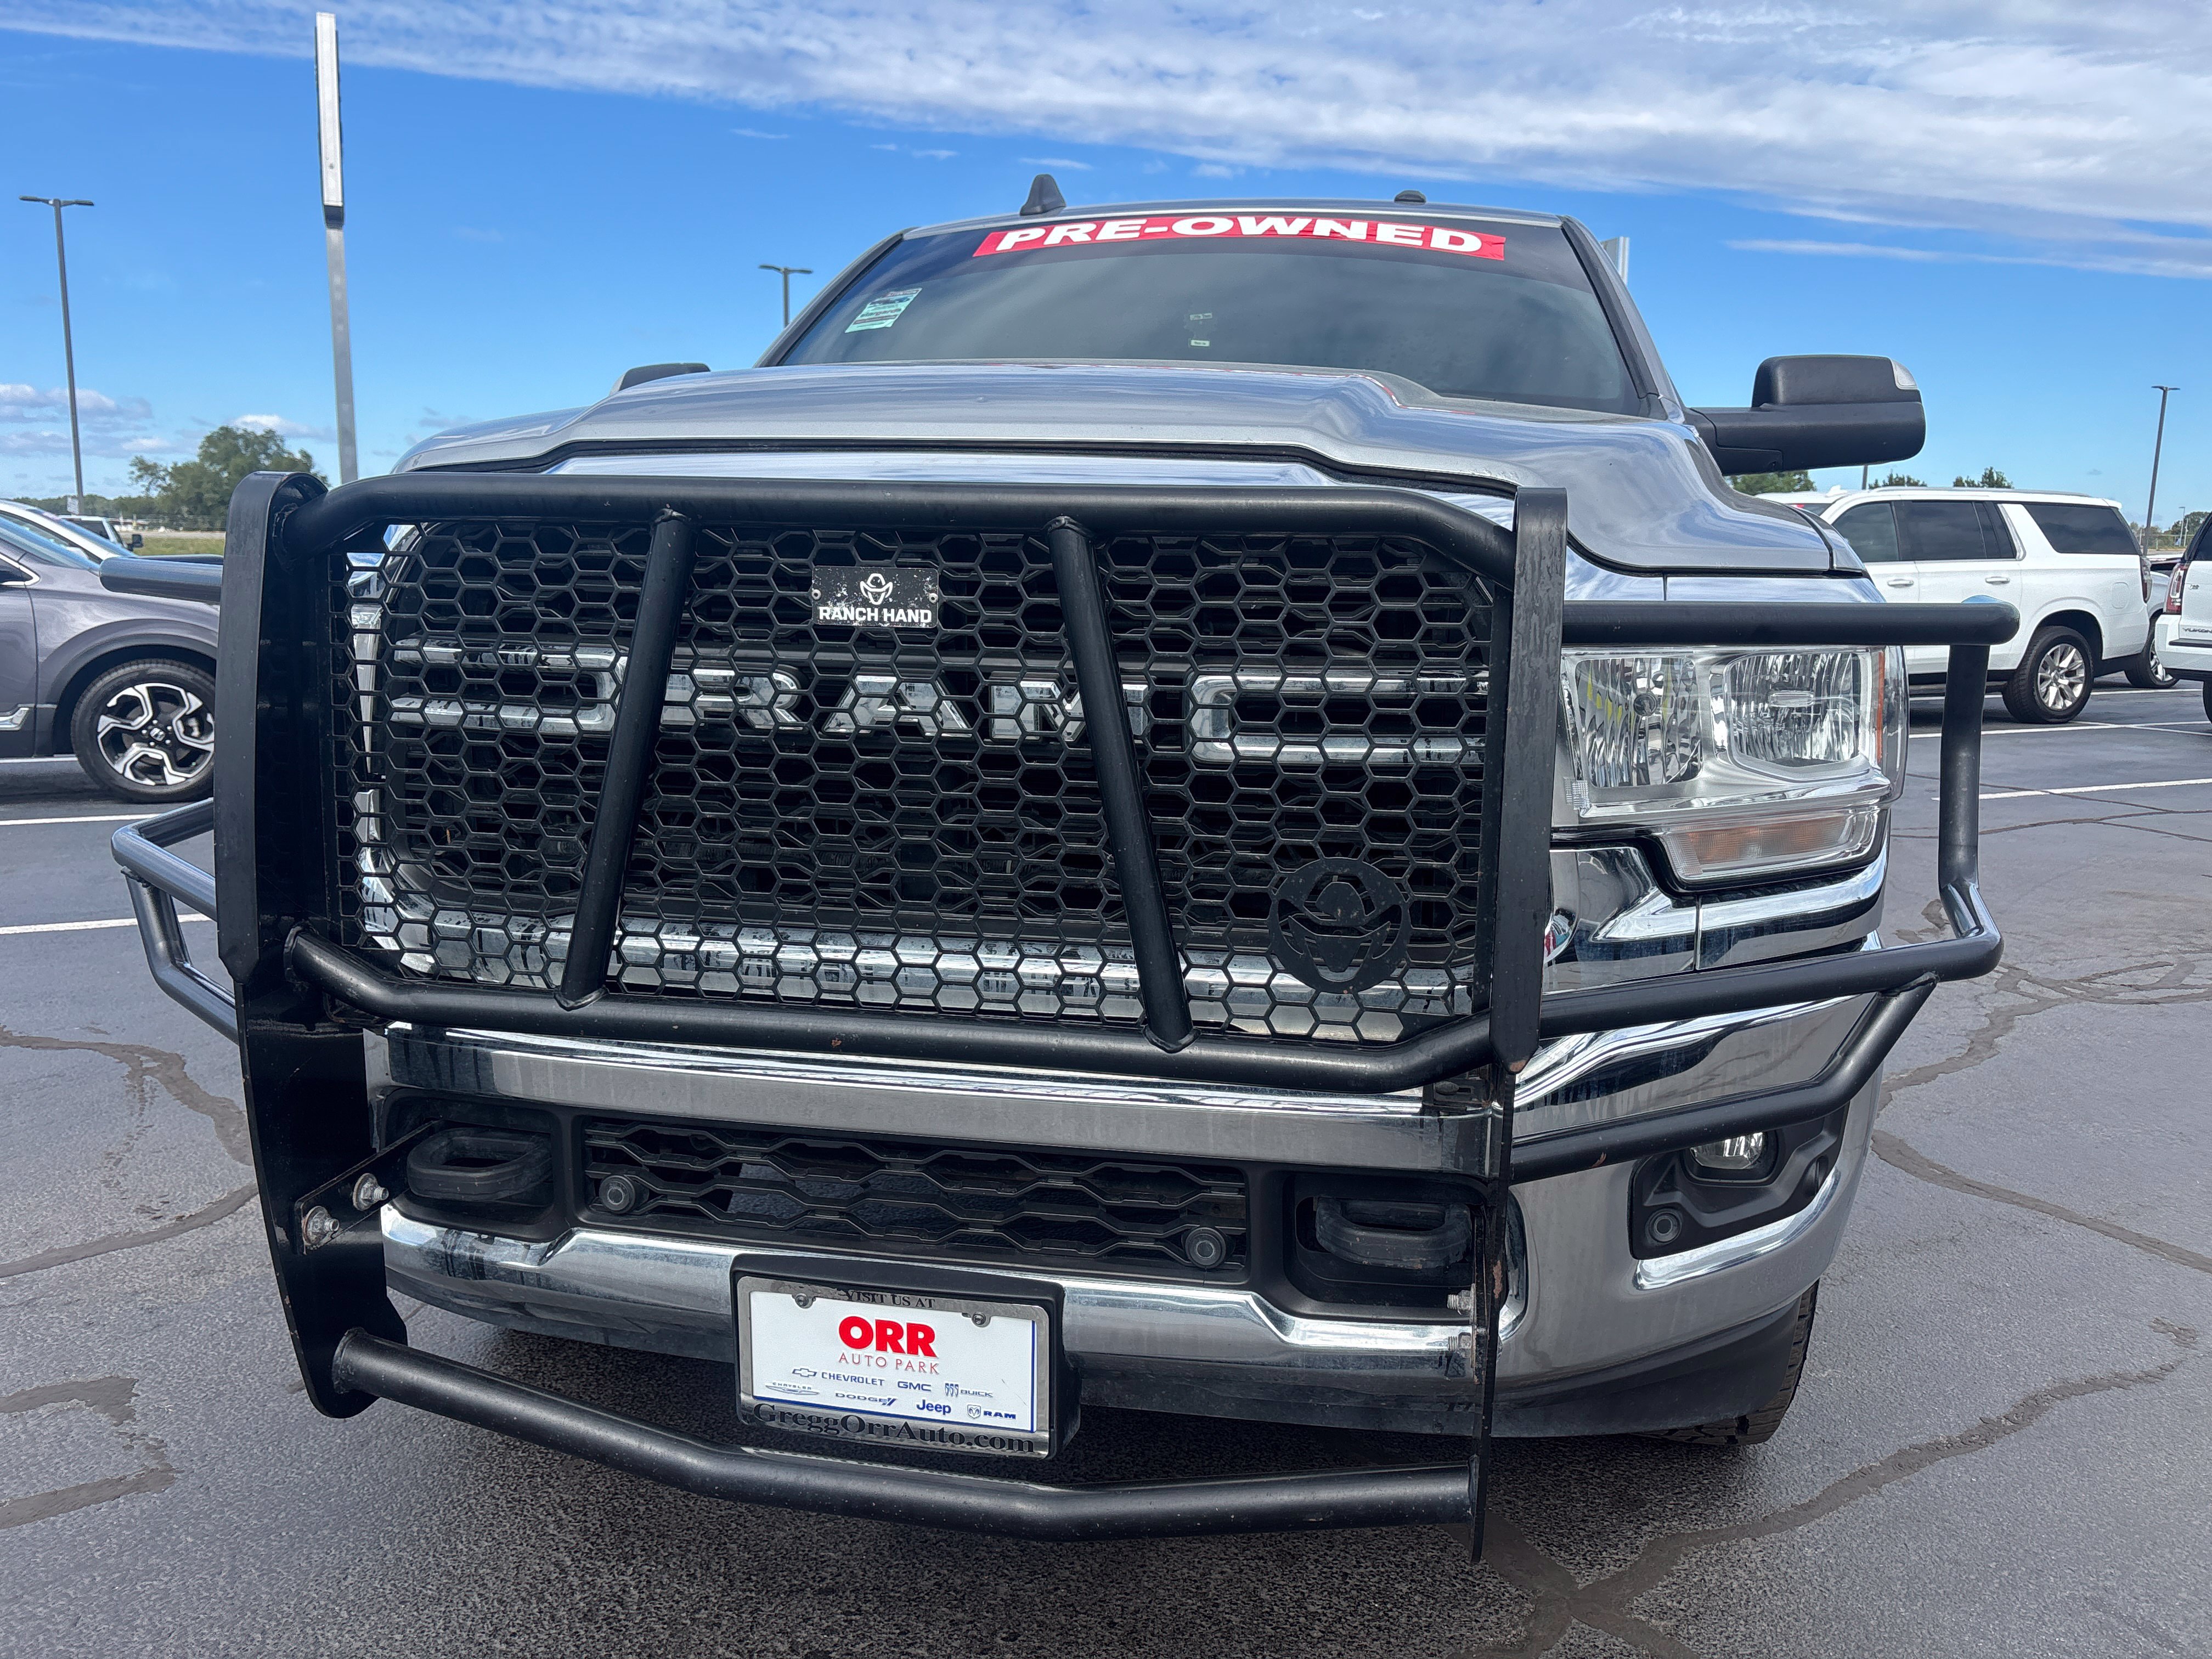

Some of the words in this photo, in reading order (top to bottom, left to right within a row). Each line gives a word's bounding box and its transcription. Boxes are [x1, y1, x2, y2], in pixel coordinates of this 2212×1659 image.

[995, 216, 1483, 253] PRE-OWNED
[818, 606, 878, 622] RANCH
[883, 608, 932, 623] HAND
[659, 667, 1149, 743] RAM
[846, 1290, 887, 1304] VISIT
[891, 1294, 911, 1307] US
[915, 1297, 935, 1308] AT
[838, 1316, 938, 1358] ORR
[839, 1352, 887, 1368] AUTO
[895, 1358, 940, 1375] PARK
[772, 1382, 812, 1390] CHRYSLER
[821, 1372, 885, 1386] CHEVROLET
[897, 1380, 932, 1392] GMC
[835, 1392, 888, 1403] DODGE
[961, 1389, 994, 1398] BUICK
[916, 1399, 952, 1415] Jeep
[983, 1410, 1017, 1419] RAM
[753, 1403, 1035, 1453] GreggOrrAuto.com
